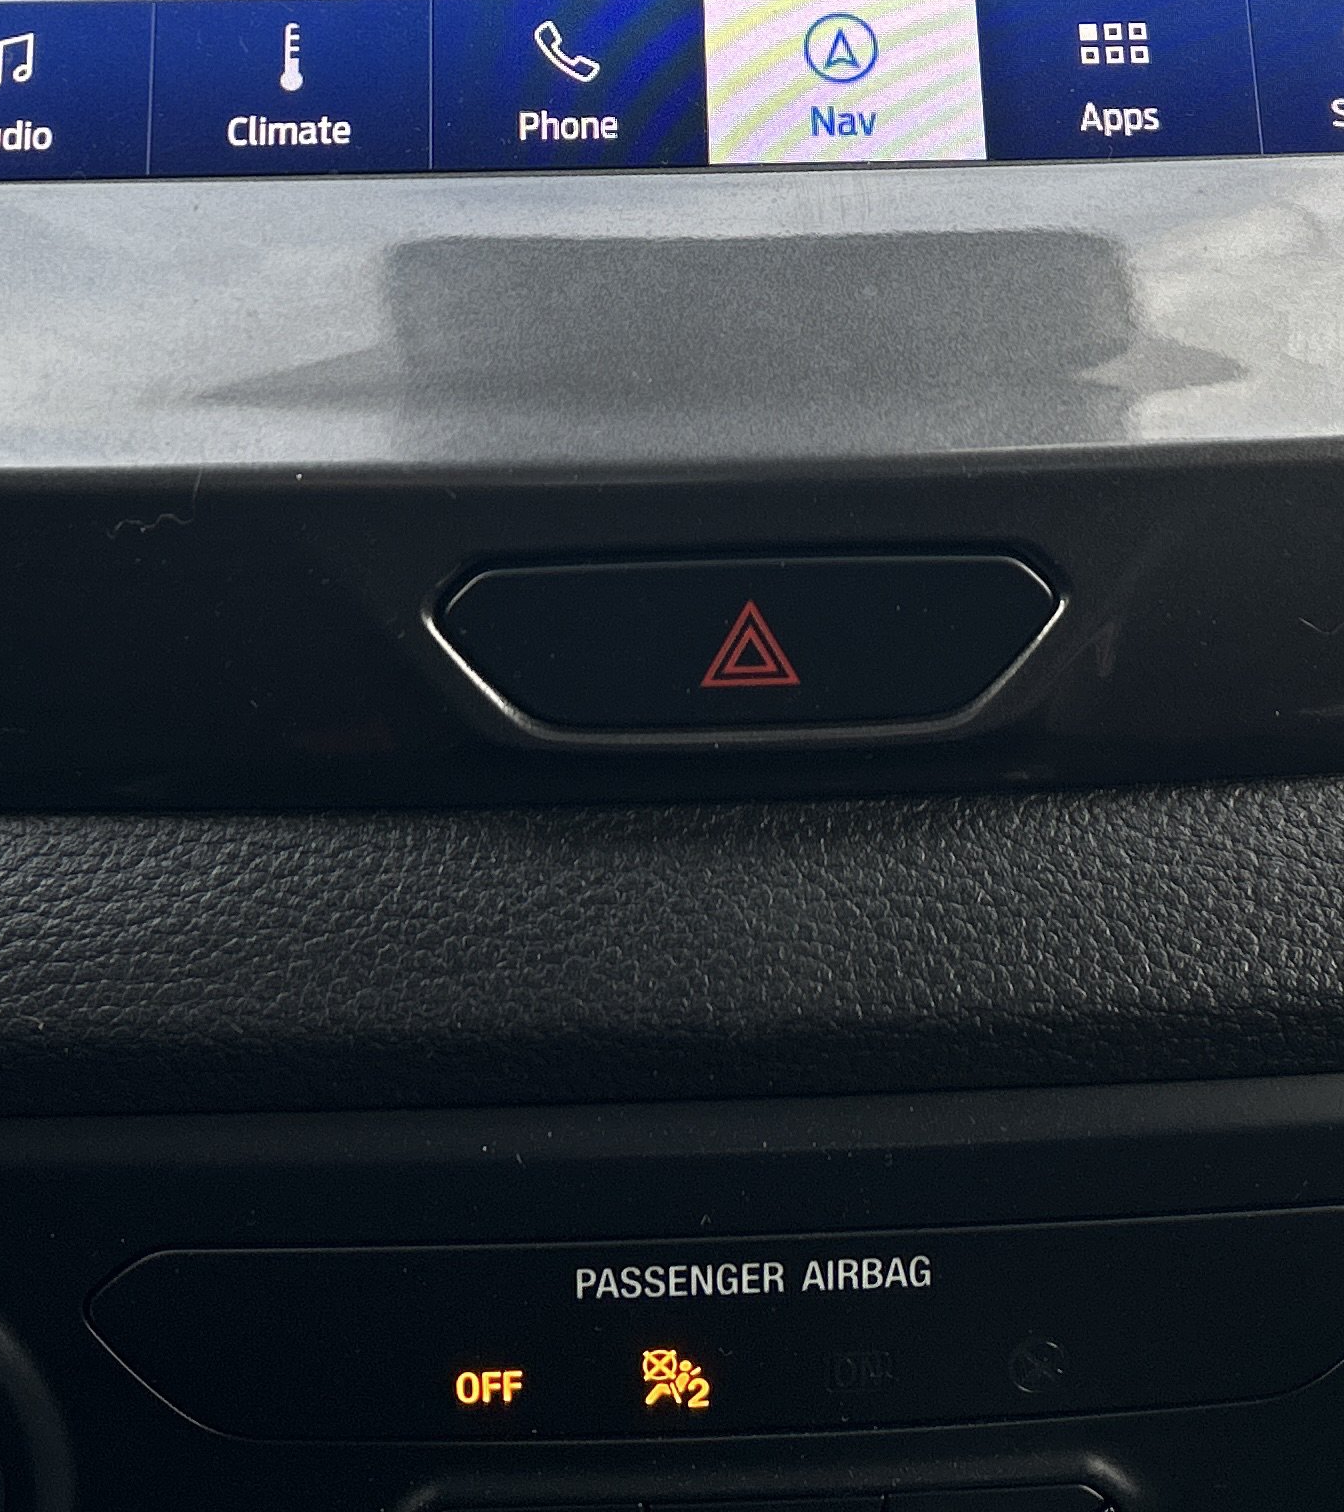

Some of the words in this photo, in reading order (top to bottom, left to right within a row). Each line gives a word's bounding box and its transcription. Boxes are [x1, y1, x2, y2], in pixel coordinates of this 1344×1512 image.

[226, 115, 352, 148] Climate
[518, 110, 619, 142] Phone
[810, 105, 878, 138] Nav
[1079, 101, 1161, 138] Apps
[575, 1261, 785, 1300] PASSENGER
[801, 1255, 933, 1292] AIRBAG
[455, 1370, 523, 1405] OFF
